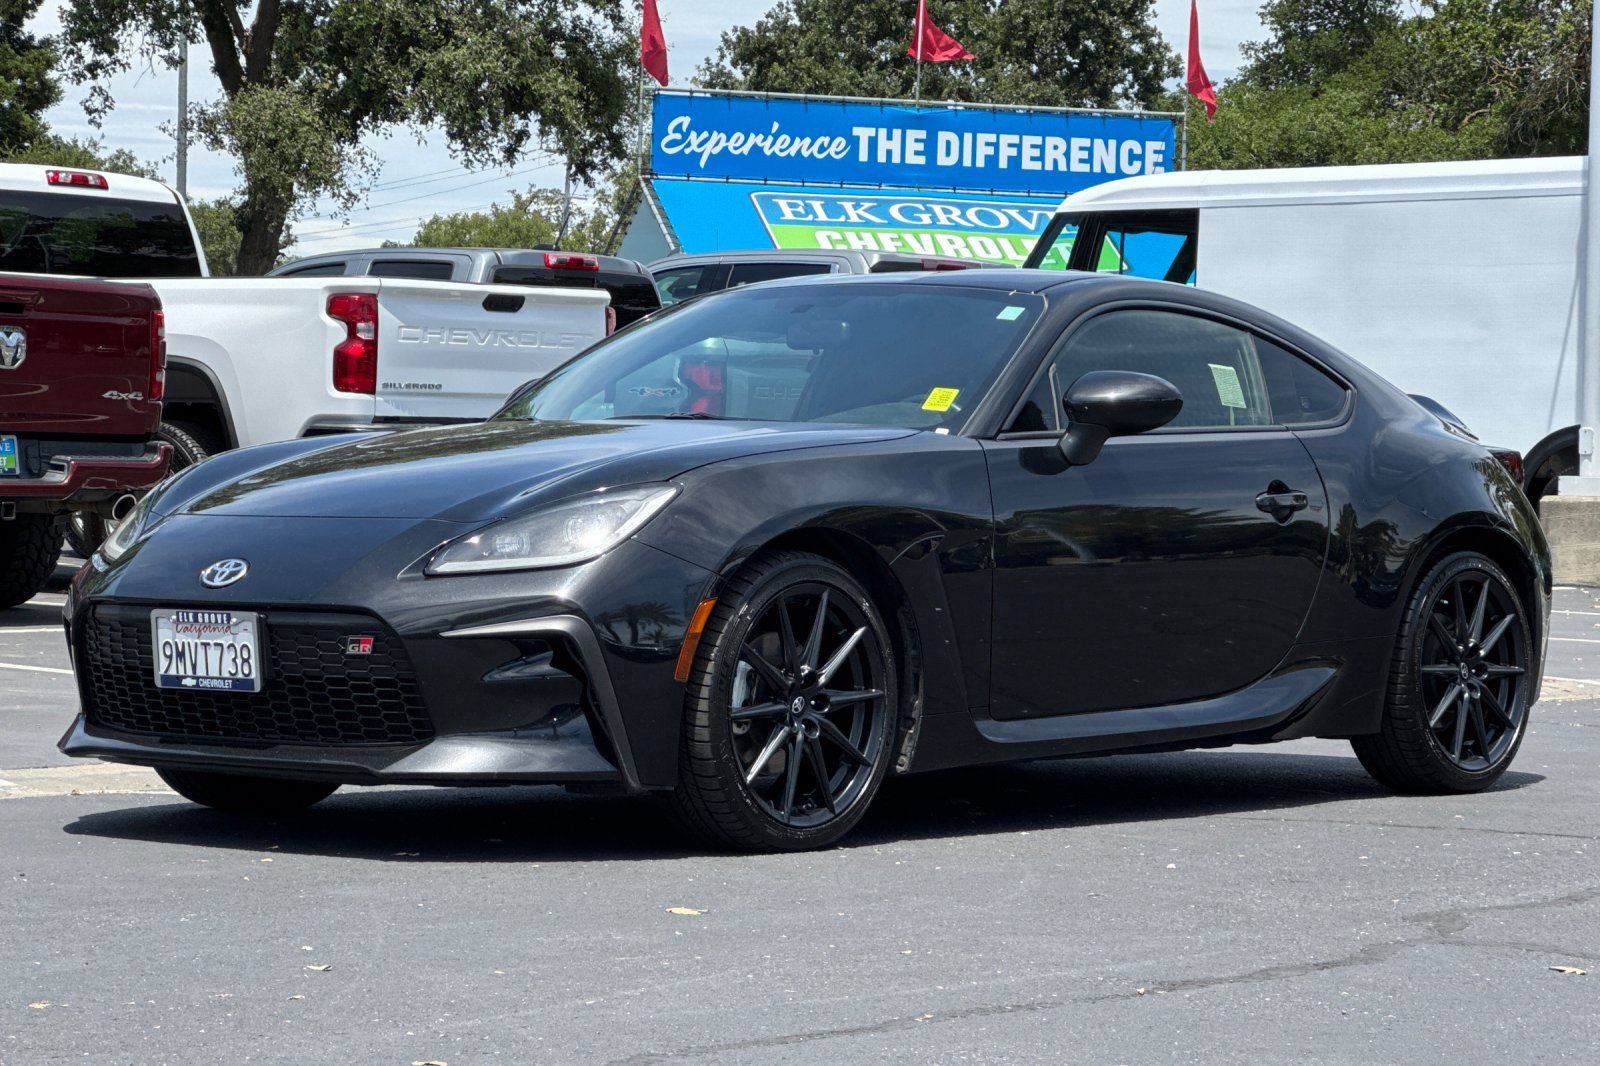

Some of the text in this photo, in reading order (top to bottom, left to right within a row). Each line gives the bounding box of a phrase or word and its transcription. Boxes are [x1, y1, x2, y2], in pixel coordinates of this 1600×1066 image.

[661, 116, 1166, 175] Experience THE DIFFERENCE
[772, 198, 880, 224] ELK
[397, 325, 593, 349] CHEVROLET
[381, 382, 443, 391] SILVERADO
[178, 611, 228, 625] ELK GROVE
[348, 643, 371, 653] GR
[162, 640, 253, 677] 9MVT738
[198, 678, 233, 688] CHEVROLET
